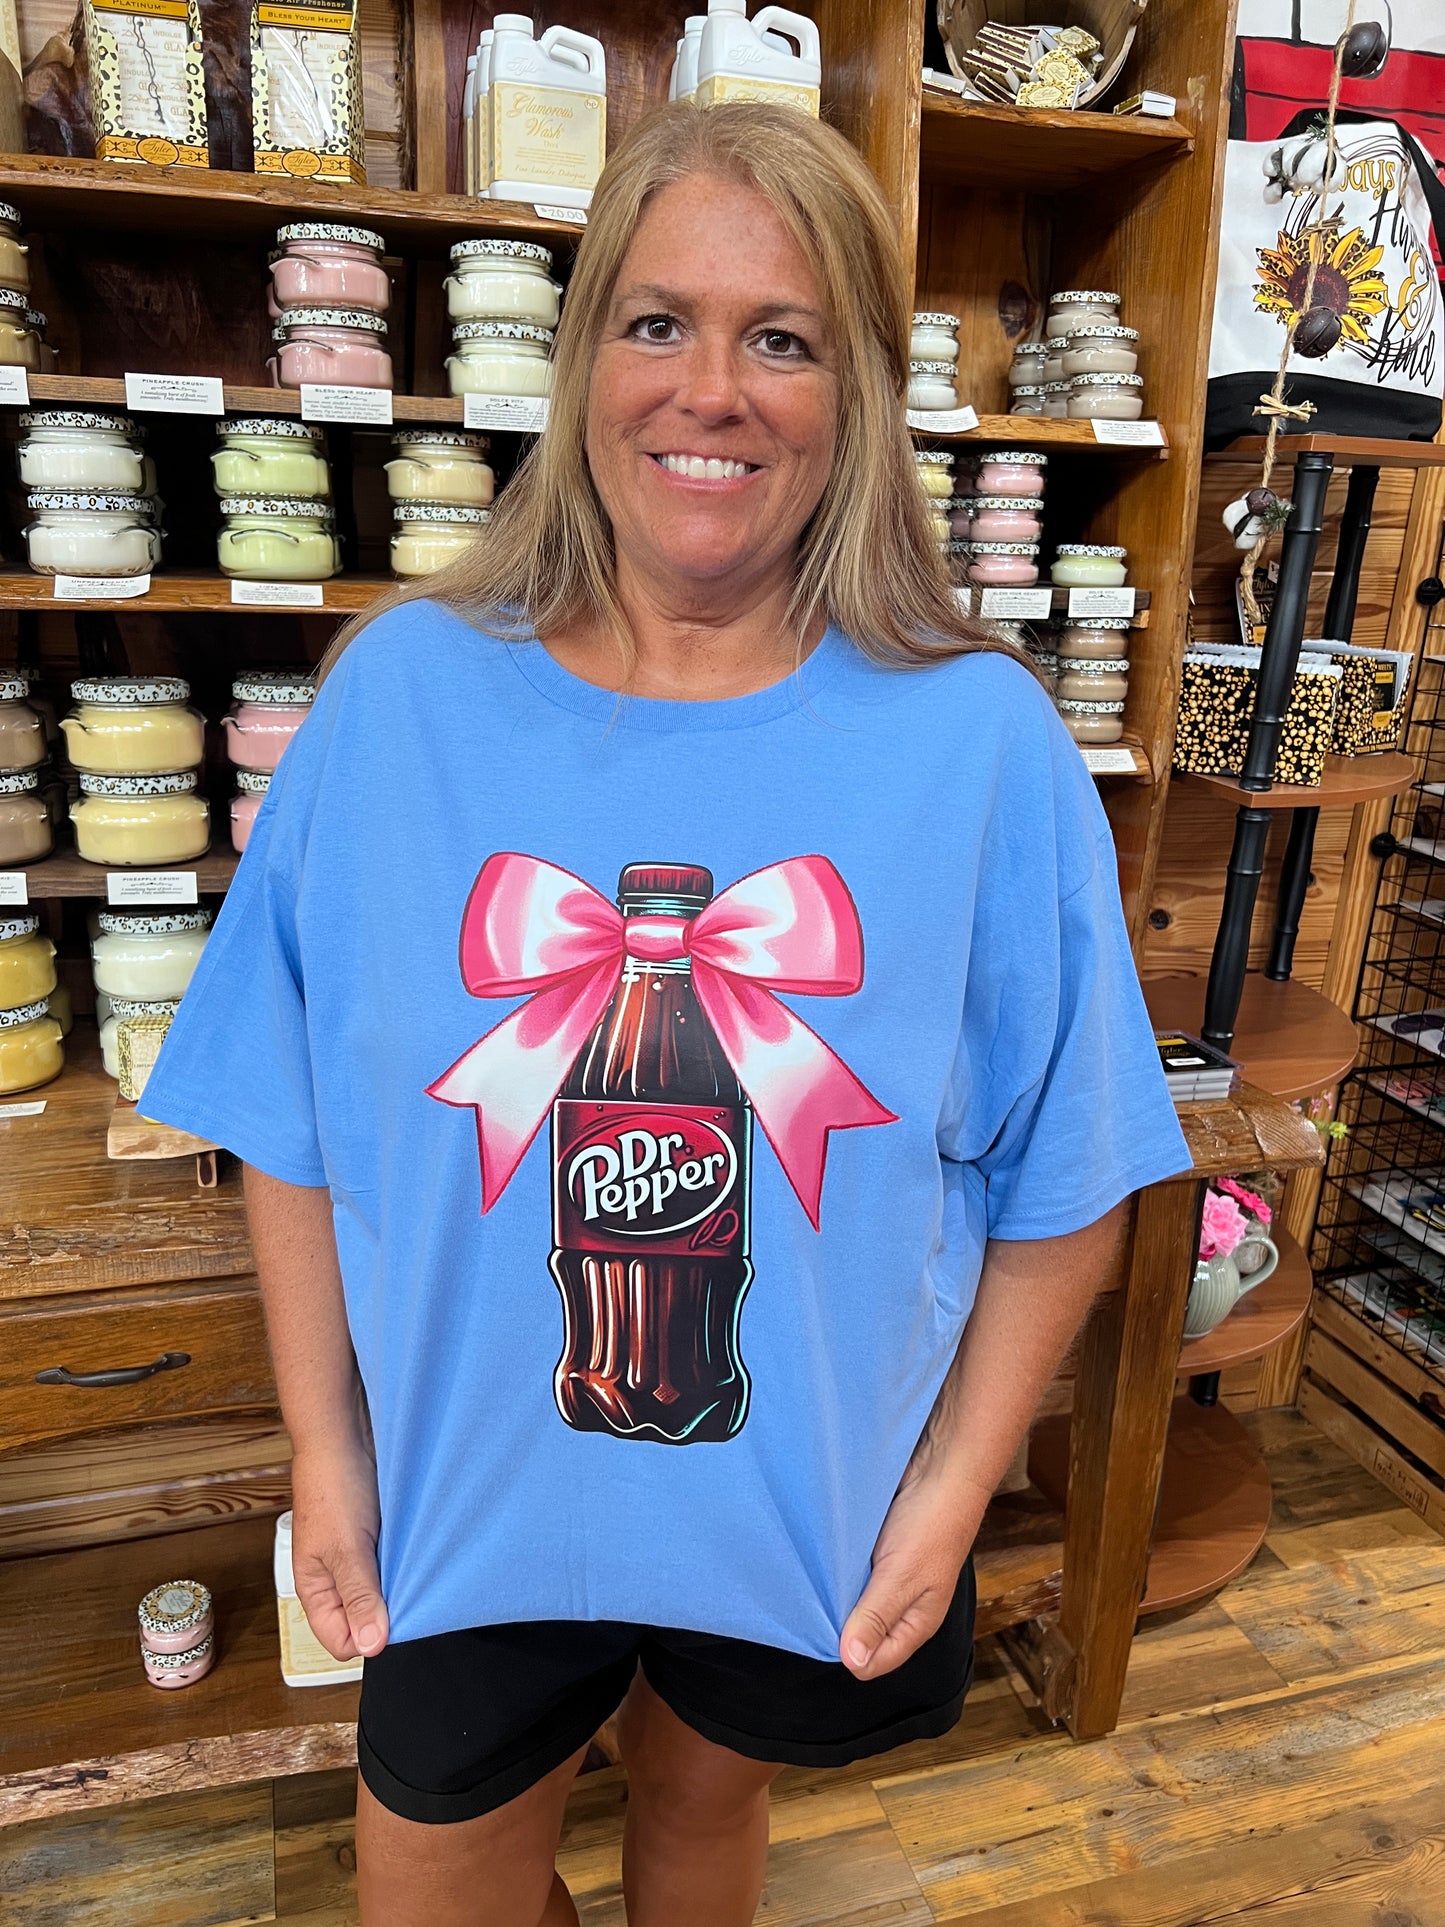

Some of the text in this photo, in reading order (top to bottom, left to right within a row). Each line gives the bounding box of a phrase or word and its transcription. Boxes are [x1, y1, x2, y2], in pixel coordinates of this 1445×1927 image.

[112, 0, 162, 10] PLATINUM
[268, 11, 292, 19] BLESS
[295, 14, 315, 22] YOUR
[506, 92, 574, 119] Glamorous
[524, 117, 564, 139] Wash
[143, 140, 172, 154] Tyler
[568, 1144, 726, 1222] Pepper
